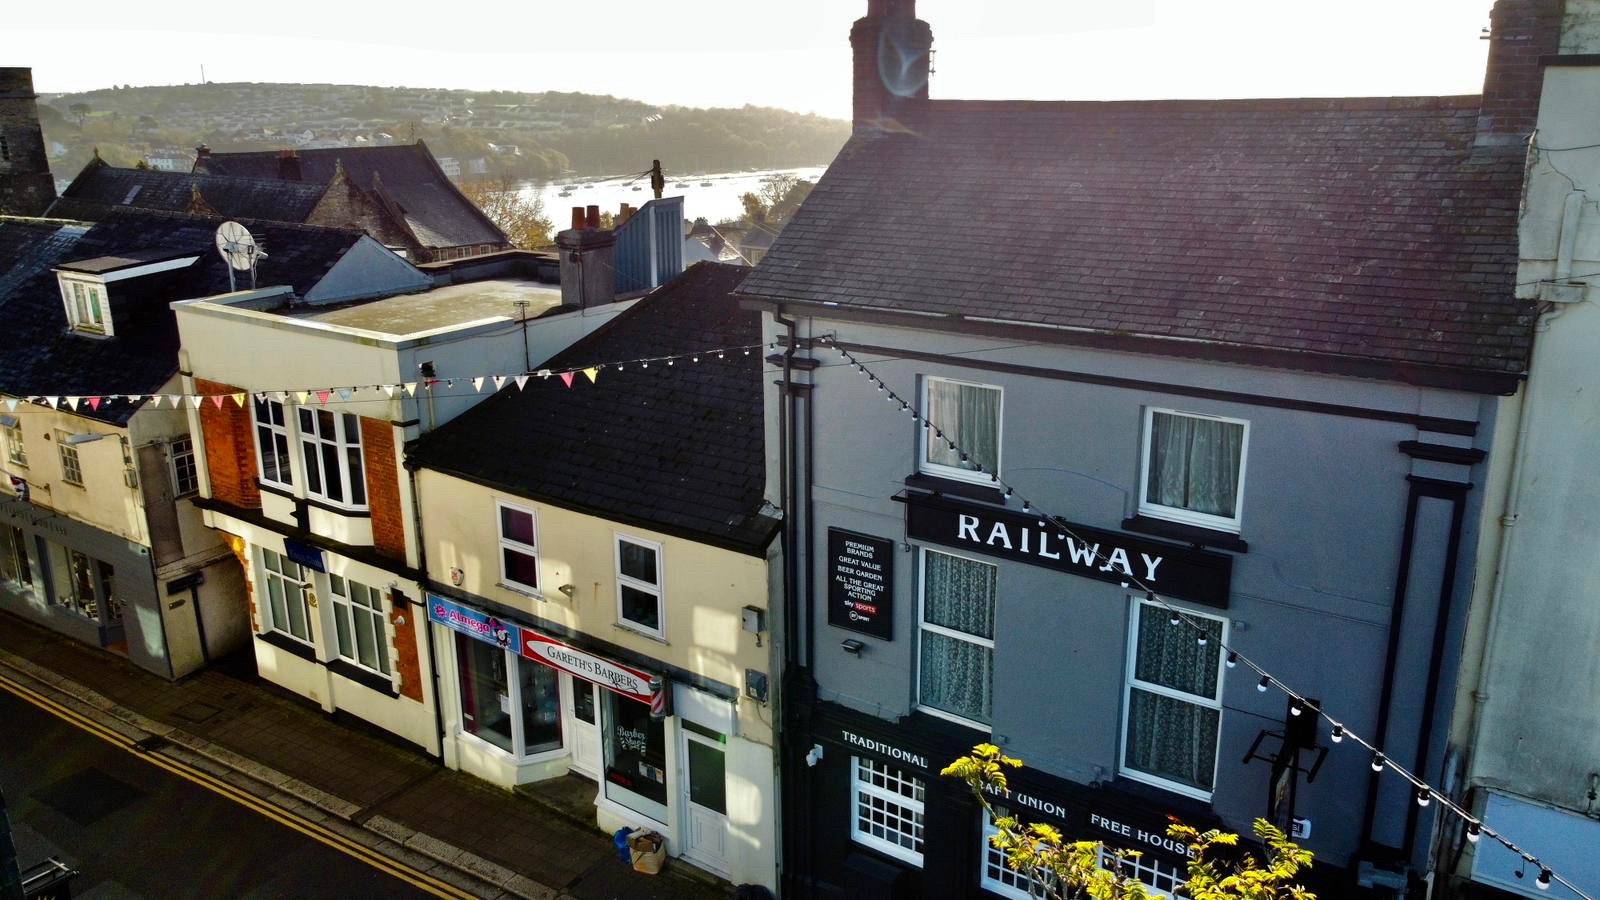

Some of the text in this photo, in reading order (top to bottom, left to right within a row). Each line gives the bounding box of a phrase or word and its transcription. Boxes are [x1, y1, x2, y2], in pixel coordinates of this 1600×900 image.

[845, 540, 875, 552] PREMIUM
[846, 547, 873, 558] BRANDS
[957, 513, 1164, 582] RAILWAY
[838, 555, 882, 571] GREAT VALUE
[837, 564, 883, 581] BEER GARDEN
[835, 574, 885, 591] ALL THE GREAT
[843, 583, 876, 596] SPORTING
[847, 590, 872, 601] ACTION
[855, 603, 876, 612] sports
[448, 610, 491, 634] Almega
[547, 645, 593, 673] GARETH'S
[594, 662, 638, 689] BARBERS
[616, 725, 646, 741] Barber
[841, 730, 928, 768] TRADITIONAL
[1017, 793, 1066, 818] UNION
[1091, 813, 1196, 858] FREE HOUSE
